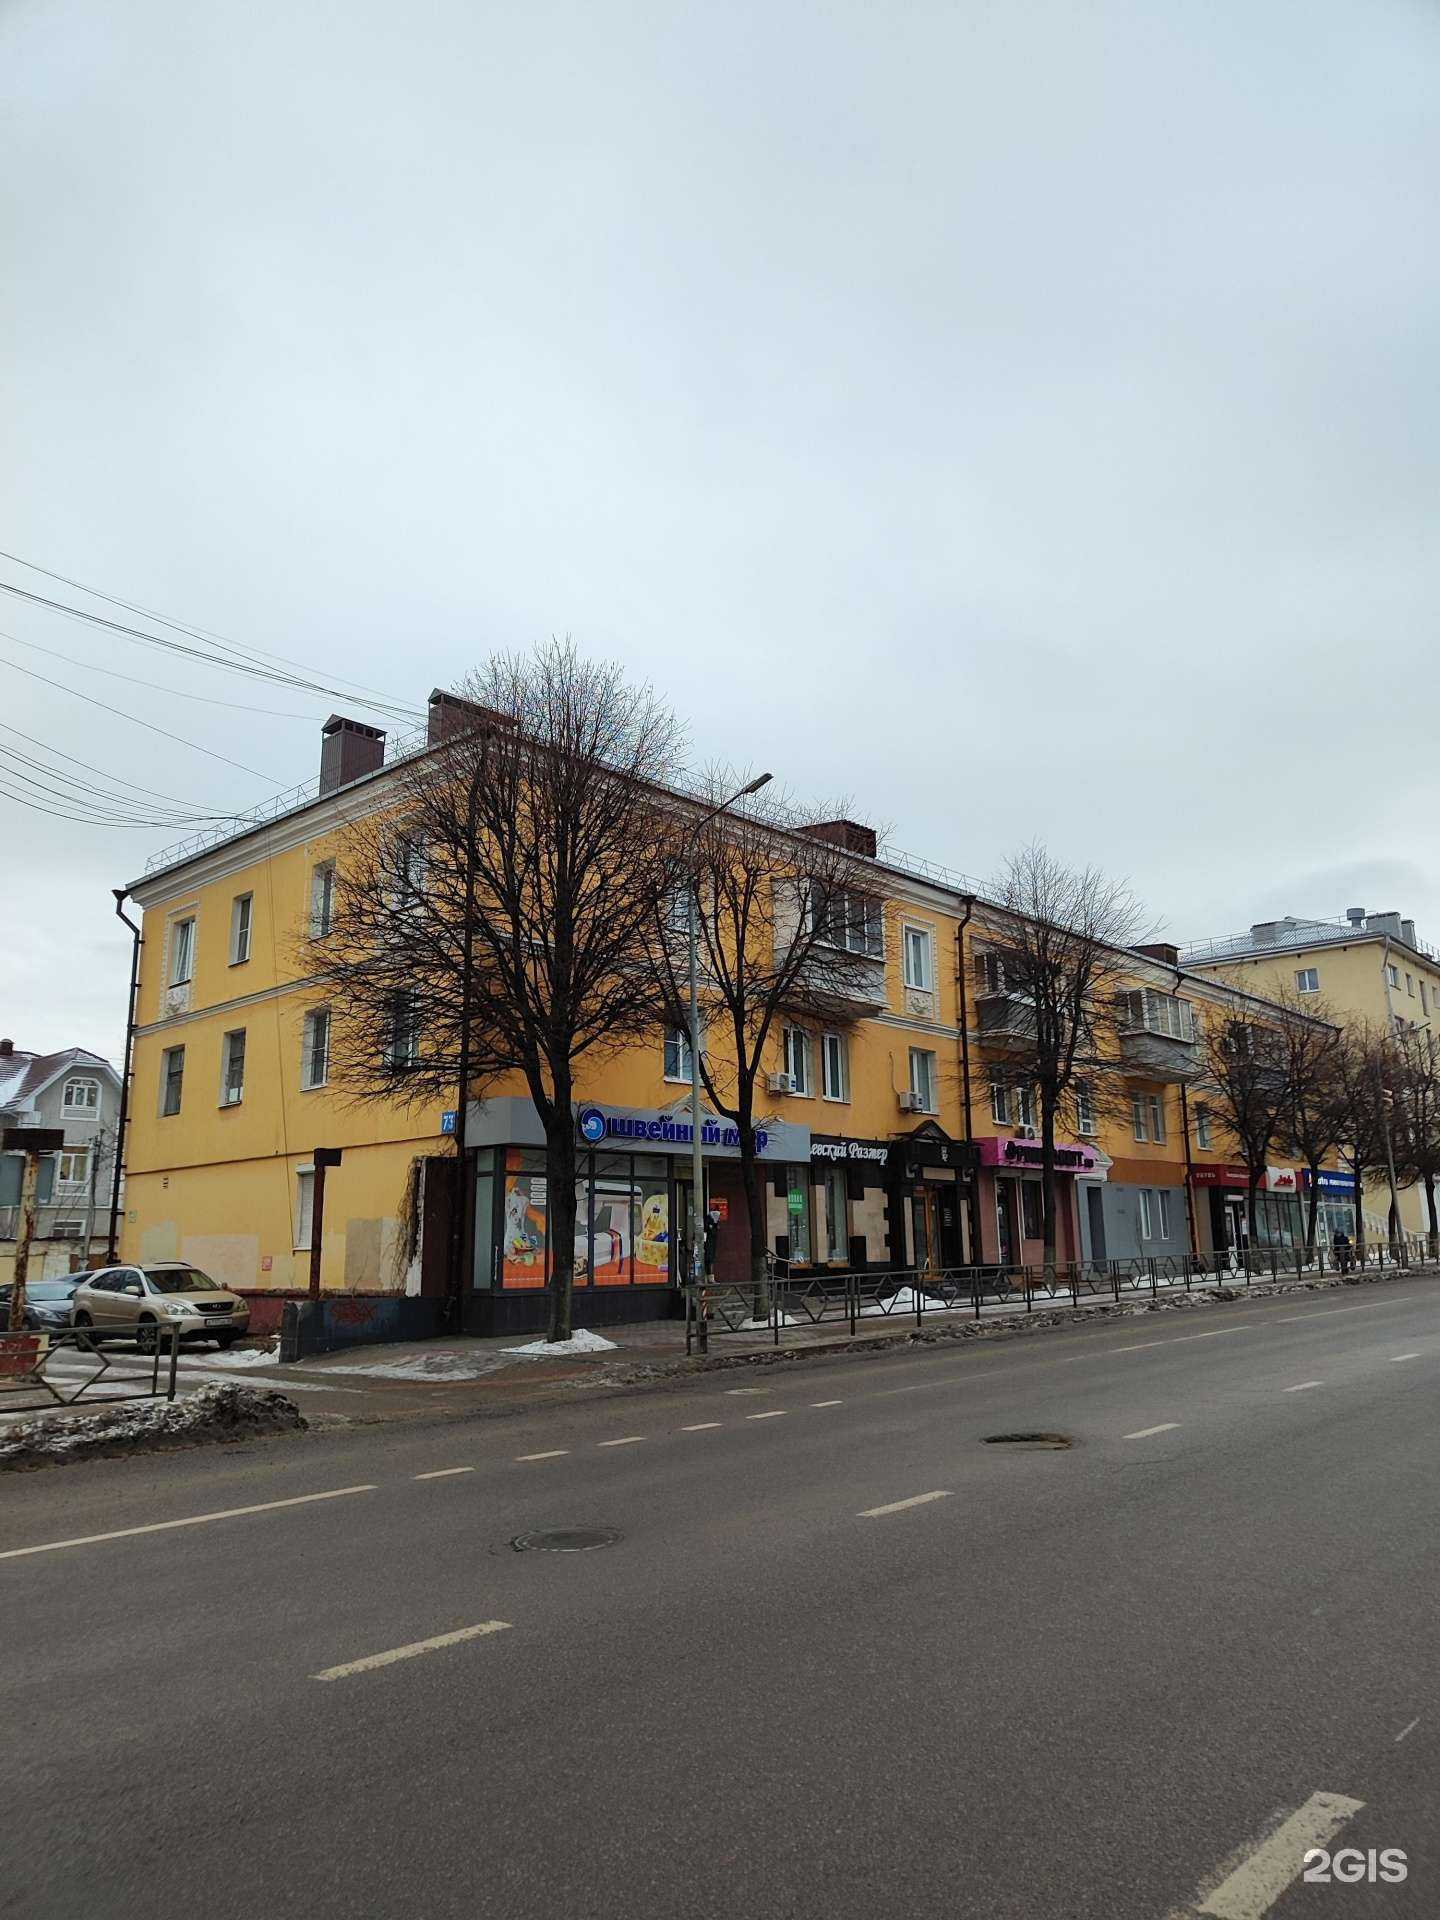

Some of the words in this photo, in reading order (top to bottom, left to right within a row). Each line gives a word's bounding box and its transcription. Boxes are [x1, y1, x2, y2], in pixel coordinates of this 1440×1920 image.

[443, 1115, 454, 1131] 73
[724, 1127, 768, 1154] мр
[810, 1142, 847, 1161] евский
[848, 1142, 889, 1166] Размер
